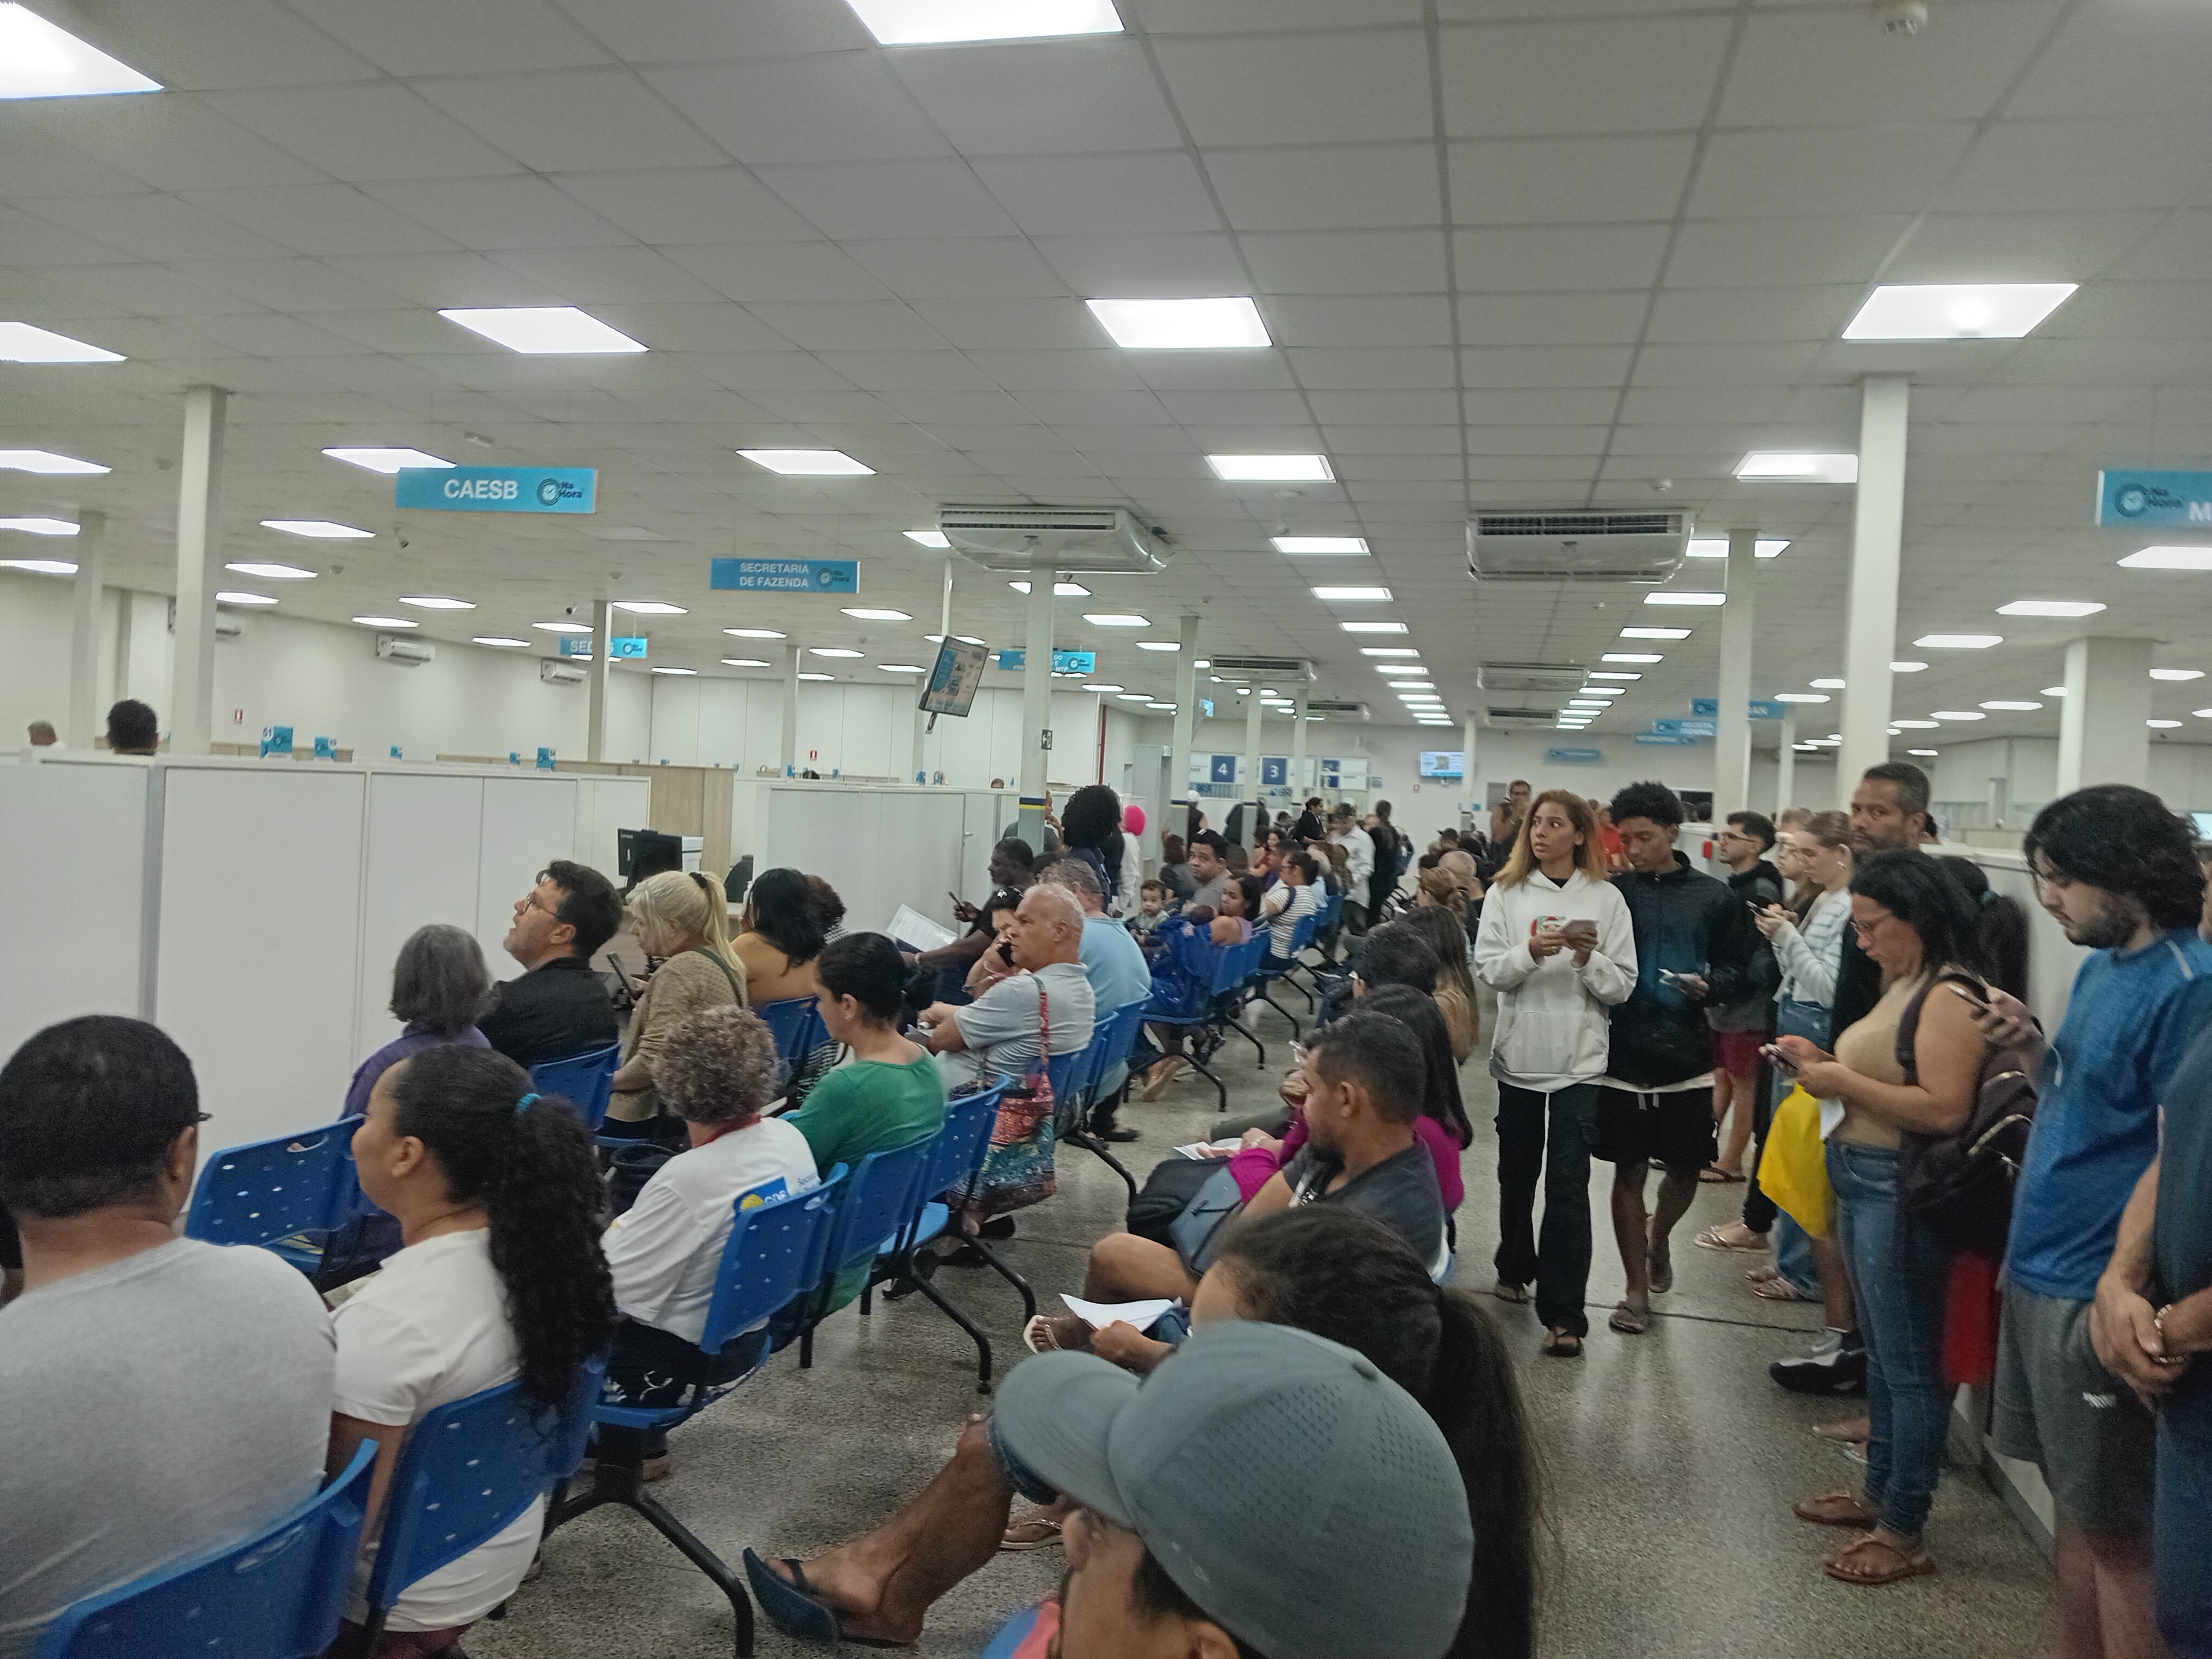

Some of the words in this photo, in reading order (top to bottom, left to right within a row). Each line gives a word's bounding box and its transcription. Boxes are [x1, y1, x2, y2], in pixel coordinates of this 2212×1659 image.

[443, 478, 519, 500] CAESB
[561, 481, 575, 489] Na
[559, 489, 583, 498] Hora
[739, 562, 810, 574] SECRETARIA
[739, 576, 754, 587] DE
[757, 577, 809, 588] FAZENDA
[1218, 763, 1229, 776] 4
[1269, 765, 1279, 778] 3
